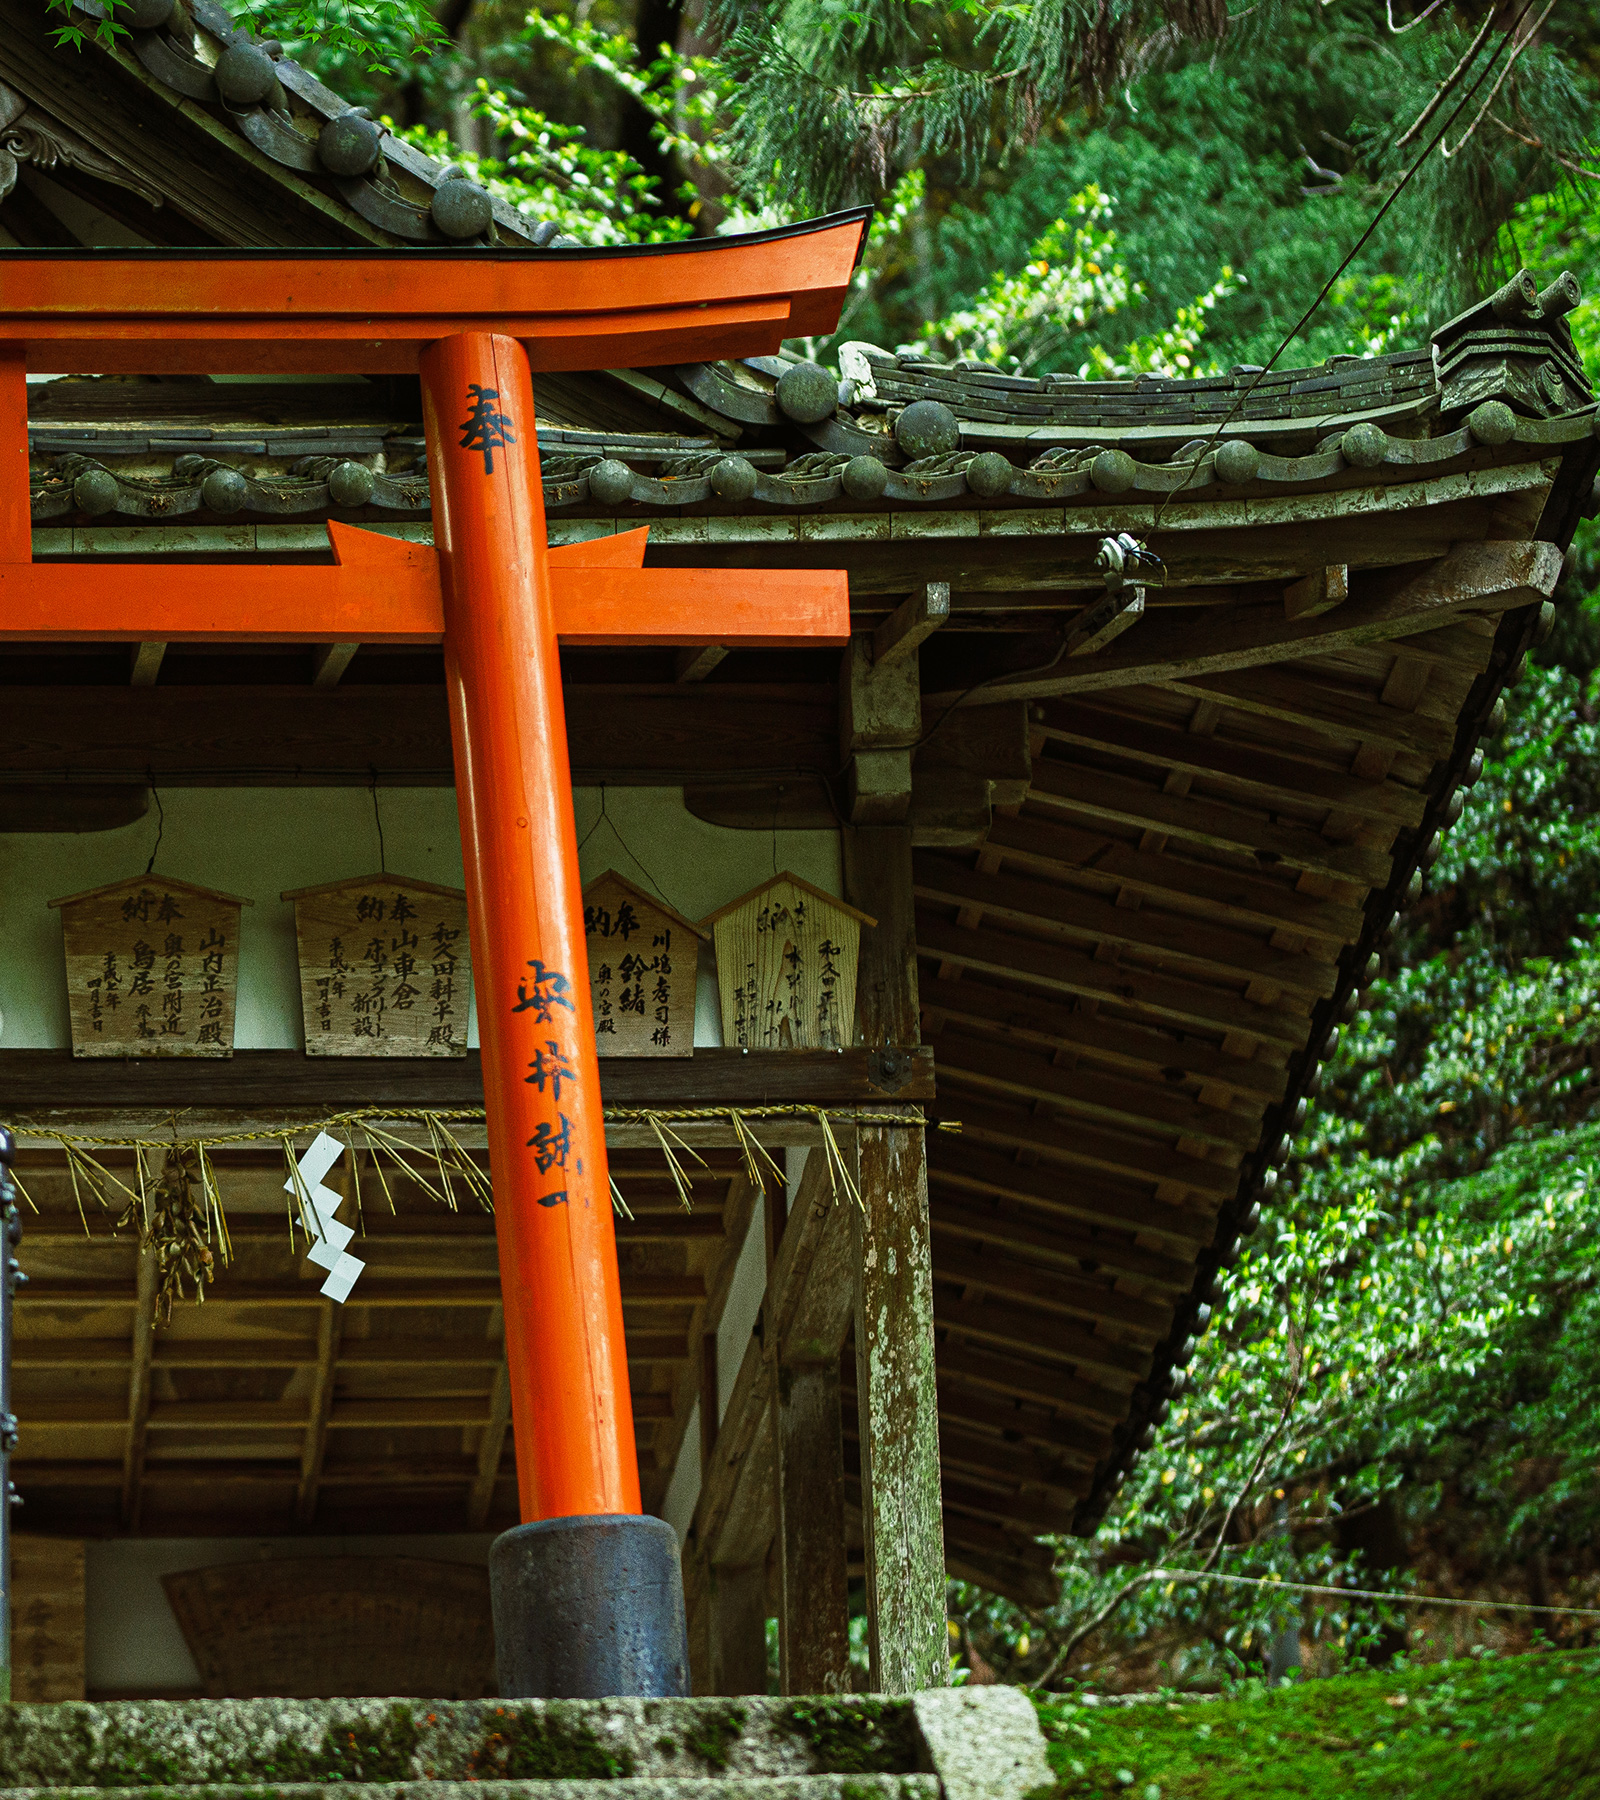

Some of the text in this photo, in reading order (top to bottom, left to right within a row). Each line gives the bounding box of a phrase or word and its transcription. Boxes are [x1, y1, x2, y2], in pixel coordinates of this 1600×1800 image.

[459, 383, 517, 476] 奉
[121, 888, 185, 925] 奉納
[356, 894, 418, 924] 奉納
[584, 901, 640, 941] 奉納
[103, 951, 122, 1010] 平成七年
[195, 928, 227, 1047] 山内正治殿
[329, 936, 348, 999] 平成六年
[315, 977, 331, 1031] 四月吉日
[351, 993, 374, 1037] 新設
